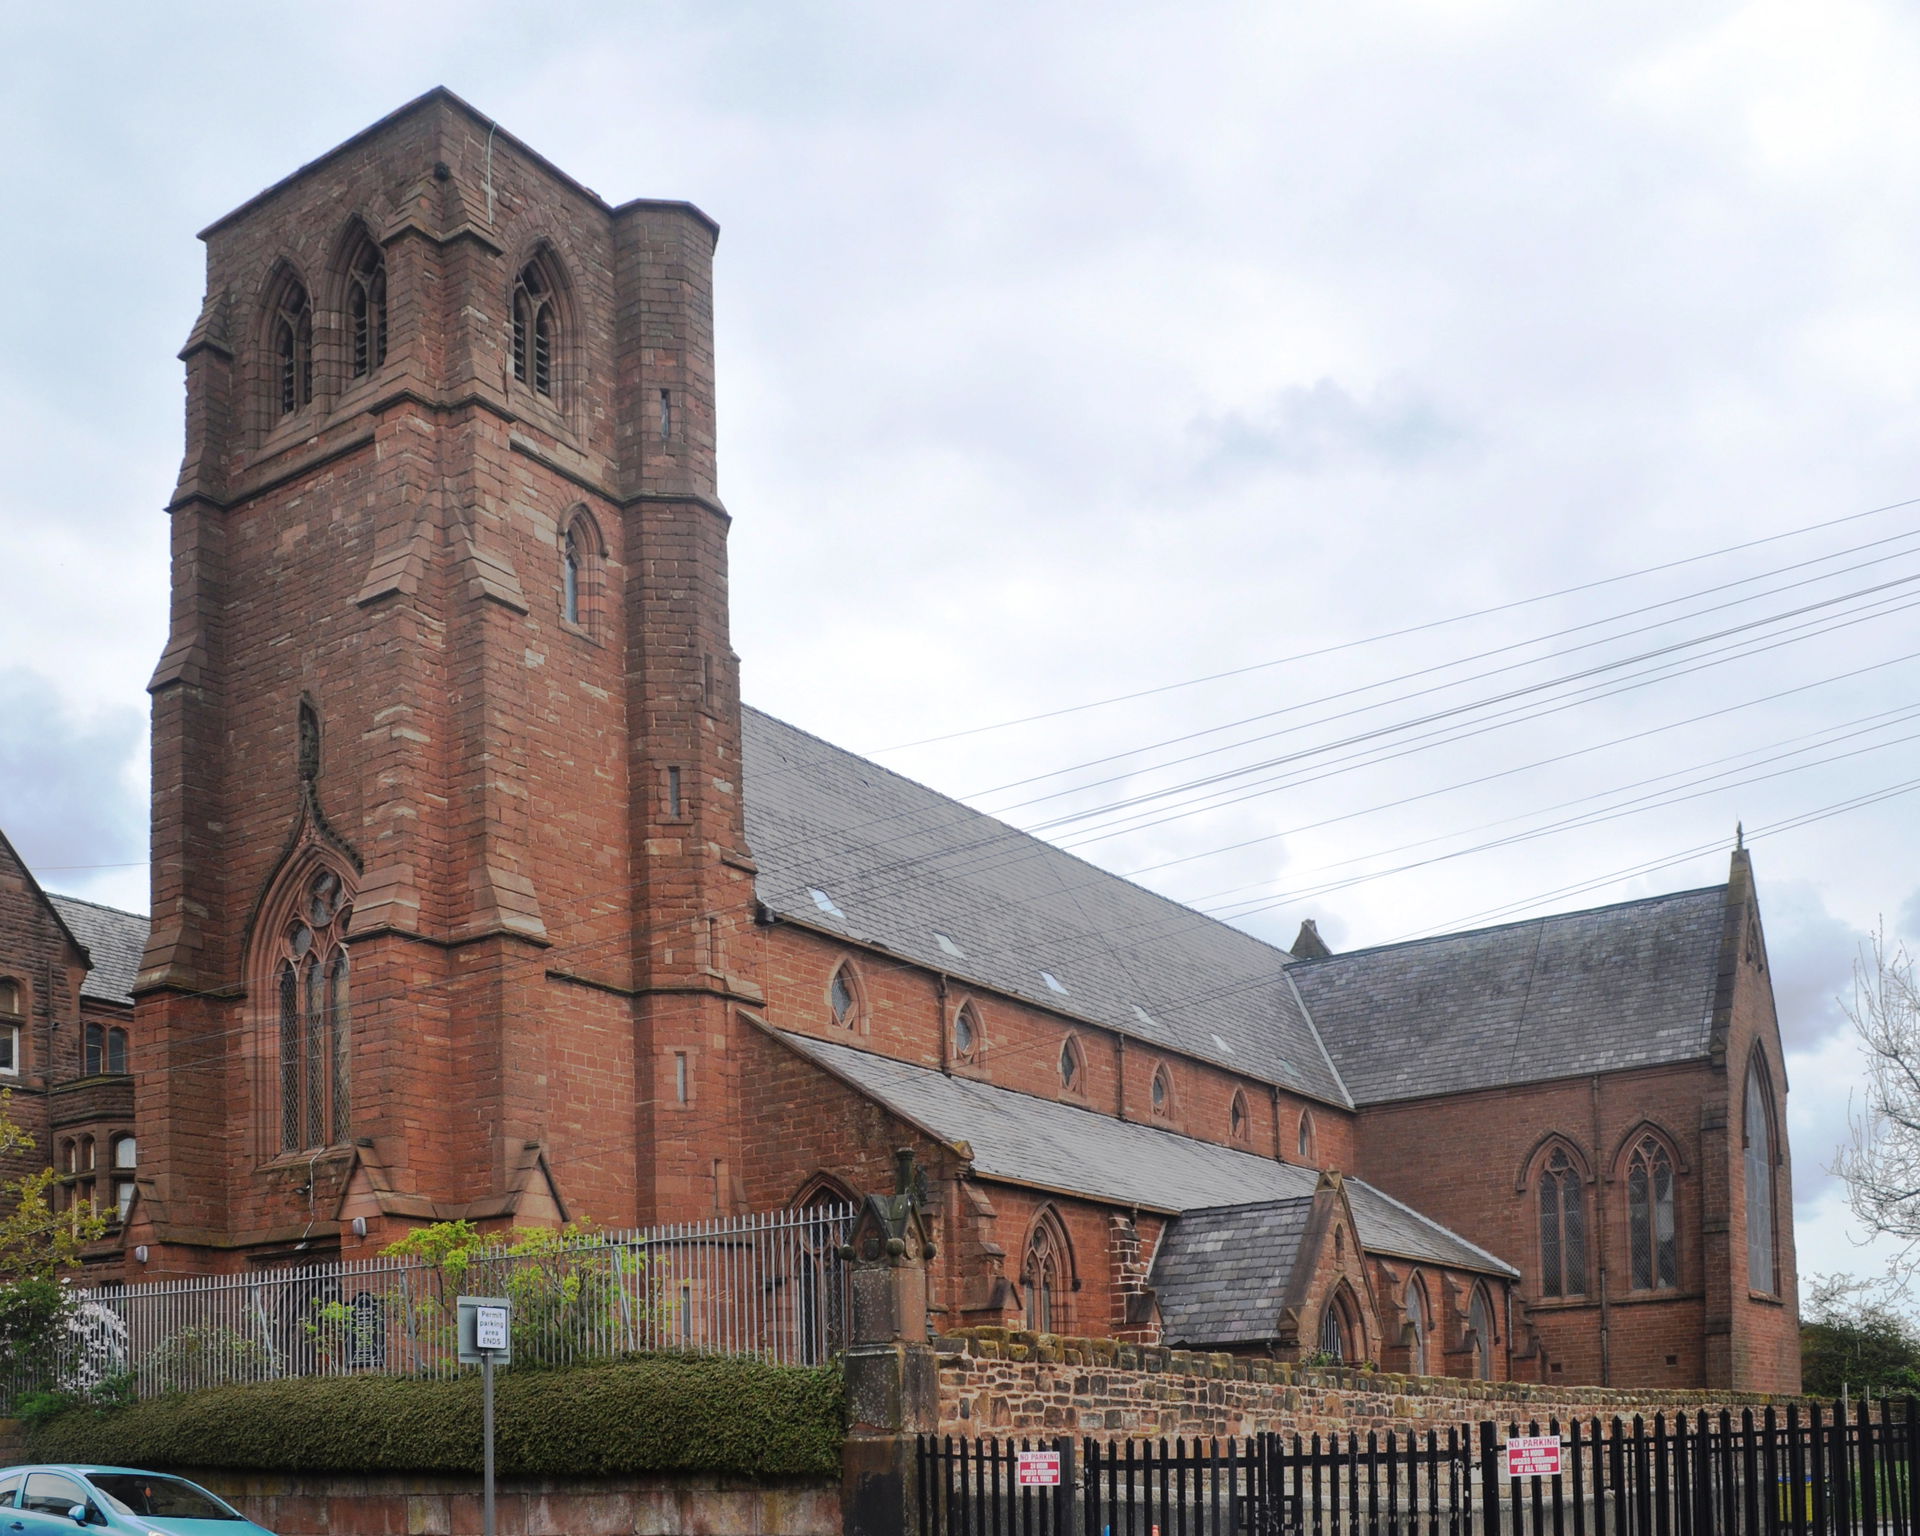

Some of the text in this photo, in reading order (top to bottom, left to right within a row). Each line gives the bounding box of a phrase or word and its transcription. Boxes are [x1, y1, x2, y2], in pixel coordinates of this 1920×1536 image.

[480, 1320, 503, 1329] parking
[482, 1337, 501, 1345] ENDS
[1508, 1438, 1558, 1448] NO PARKING
[1524, 1464, 1535, 1472] ALL
